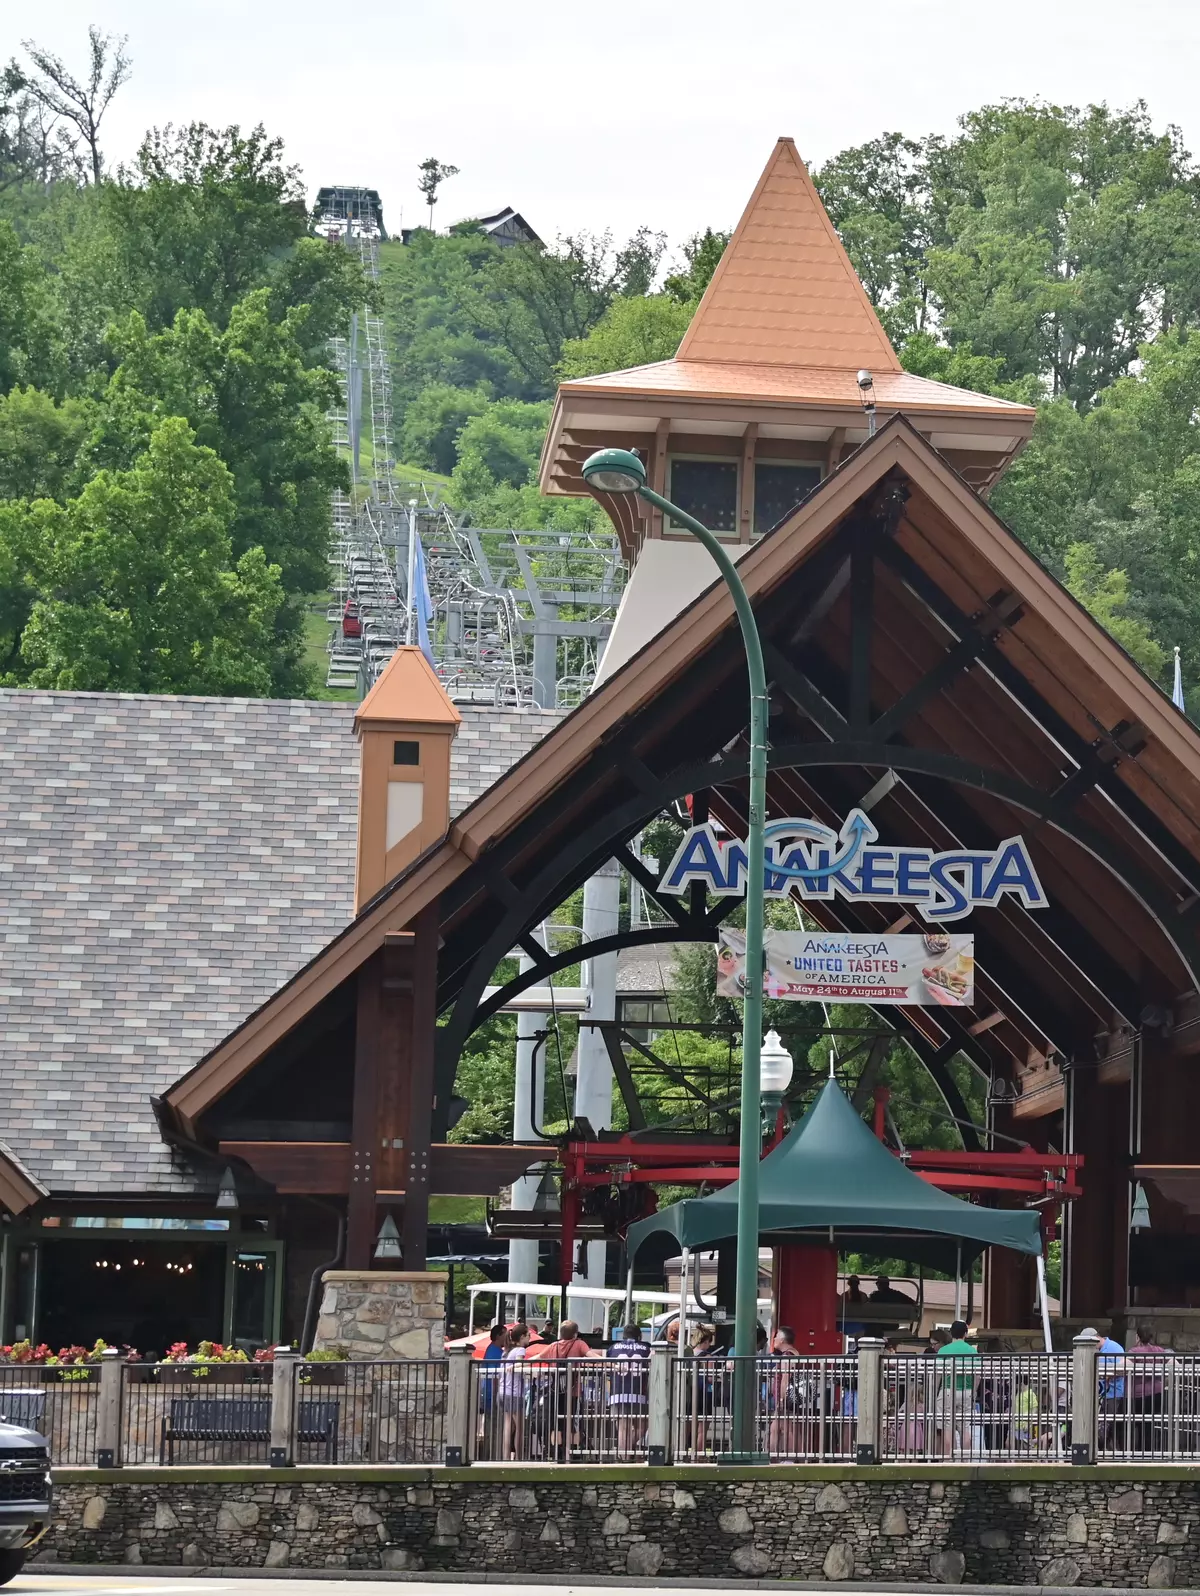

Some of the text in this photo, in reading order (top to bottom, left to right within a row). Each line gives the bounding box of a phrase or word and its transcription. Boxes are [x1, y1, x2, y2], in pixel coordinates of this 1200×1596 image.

[664, 827, 1044, 918] ANAKEESTA
[803, 938, 889, 959] ANAKEESTA
[794, 957, 899, 973] UNITED TASTES
[818, 974, 887, 985] AMERICA
[793, 985, 815, 993] May
[816, 986, 838, 994] 24th
[850, 988, 886, 997] August
